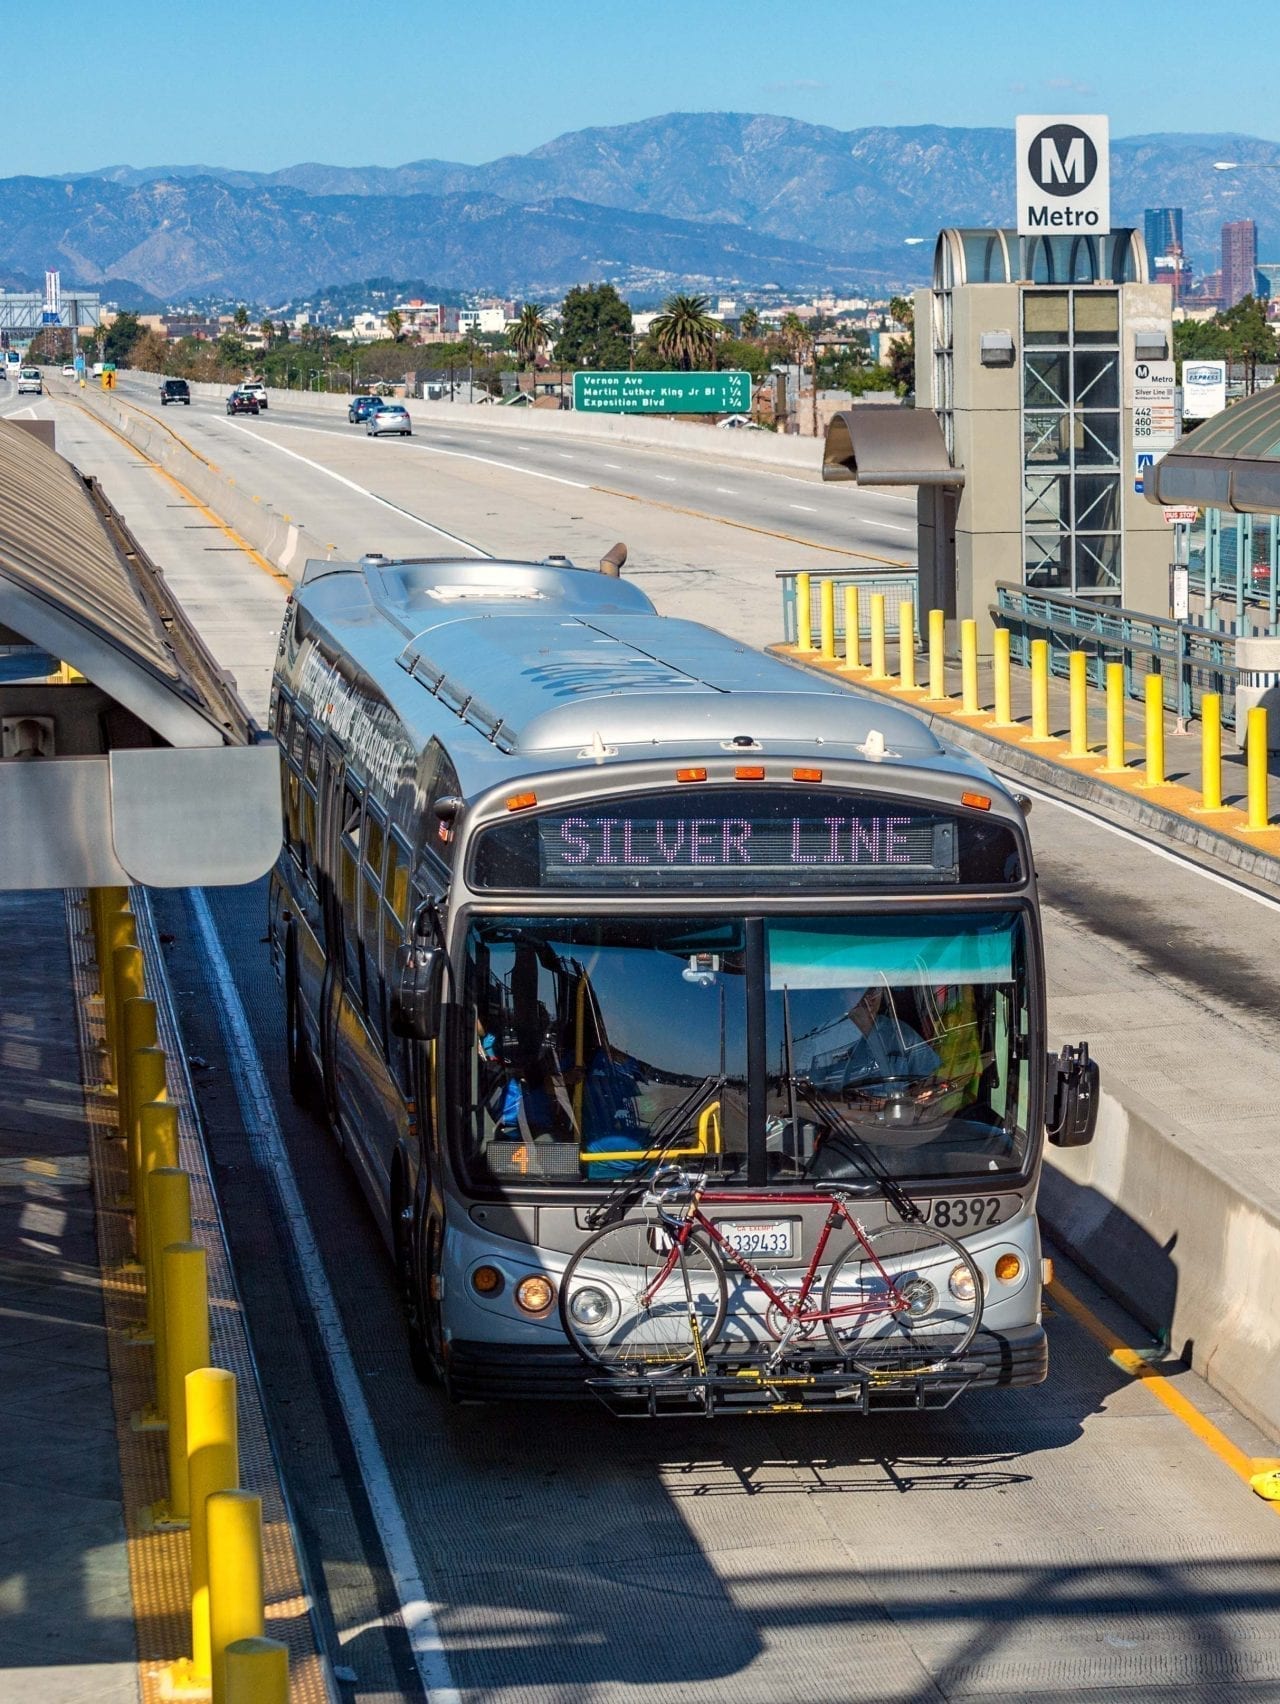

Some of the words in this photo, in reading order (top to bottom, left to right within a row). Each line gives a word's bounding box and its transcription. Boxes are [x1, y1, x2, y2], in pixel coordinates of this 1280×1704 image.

[1040, 137, 1086, 184] M
[1027, 205, 1099, 227] Metro
[1137, 366, 1148, 377] M
[583, 376, 619, 385] Vernon
[624, 376, 643, 385] Ave
[583, 388, 618, 396] Martin
[622, 388, 656, 396] Luther
[661, 388, 683, 398] King
[688, 388, 700, 396] Jr
[1135, 388, 1152, 396] Silver
[1152, 388, 1166, 396] Line
[583, 398, 637, 408] Exposition
[642, 398, 665, 407] Blvd
[1134, 407, 1151, 416] 442
[1134, 417, 1151, 426] 460
[1134, 427, 1151, 436] 550
[560, 816, 752, 864] SILVER
[791, 816, 912, 863] LINE
[512, 1146, 528, 1174] 4
[933, 1197, 1001, 1229] 8392
